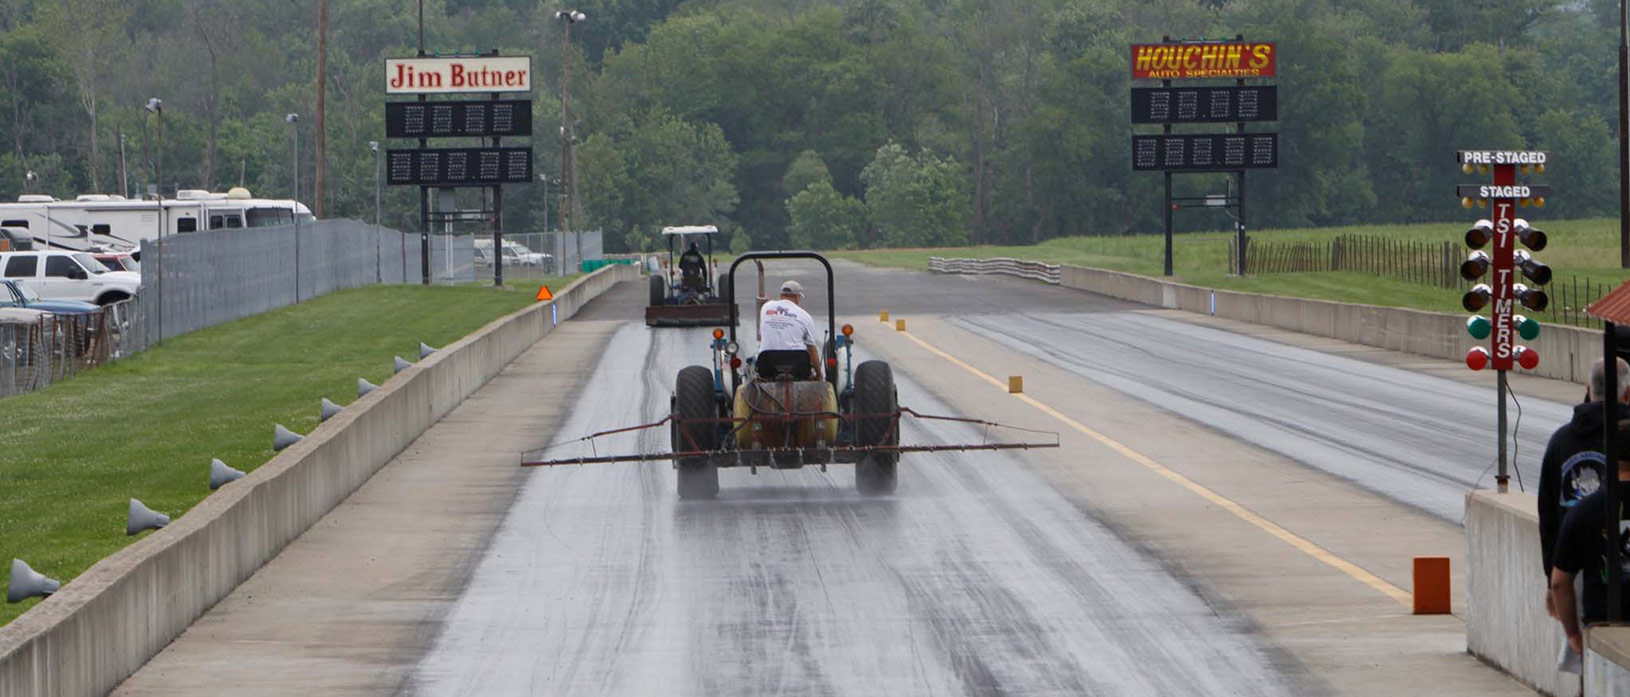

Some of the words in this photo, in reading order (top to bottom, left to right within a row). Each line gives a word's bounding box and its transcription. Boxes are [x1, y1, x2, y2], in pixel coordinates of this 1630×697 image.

[1136, 44, 1271, 70] HOUCHIN'S
[391, 64, 442, 88] Jim
[450, 64, 526, 87] Butner
[1148, 70, 1180, 78] AUTO
[1186, 68, 1260, 77] SPECIALTIES
[1464, 151, 1546, 164] PRE-STAGED
[1480, 186, 1531, 198] STAGED
[1496, 203, 1510, 248] TSI
[1495, 269, 1512, 359] TIMERS
